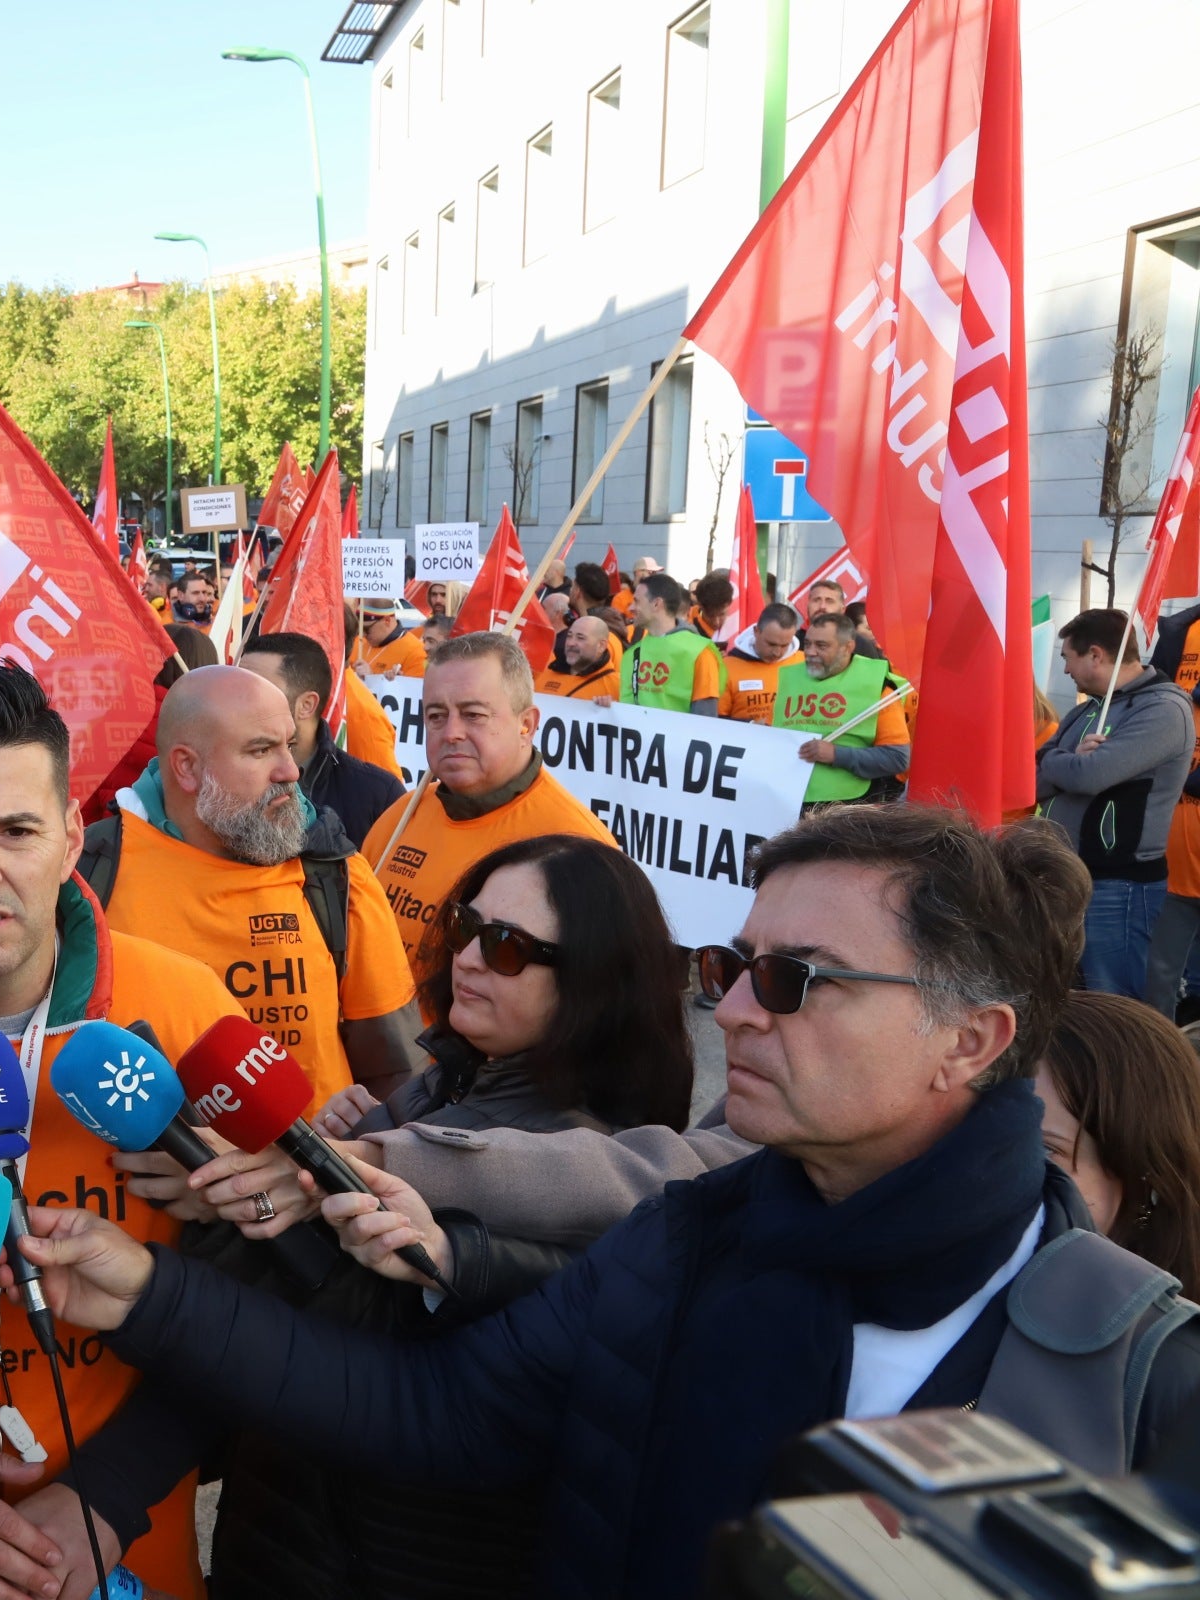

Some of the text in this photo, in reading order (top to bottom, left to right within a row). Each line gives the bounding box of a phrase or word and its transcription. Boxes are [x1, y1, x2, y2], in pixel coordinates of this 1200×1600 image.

[422, 540, 473, 551] NO ES UNA
[343, 555, 393, 567] E PRESIÓN
[422, 553, 473, 570] OPCIÓN
[363, 568, 384, 579] MÁS
[784, 692, 847, 719] USO
[537, 716, 668, 789] ONTRA
[682, 738, 746, 801] DE
[386, 883, 437, 925] Hitac
[250, 915, 284, 931] UGT
[278, 932, 303, 945] FICA
[247, 1004, 308, 1025] USTO
[235, 1035, 288, 1086] rne
[36, 1173, 126, 1222] chi
